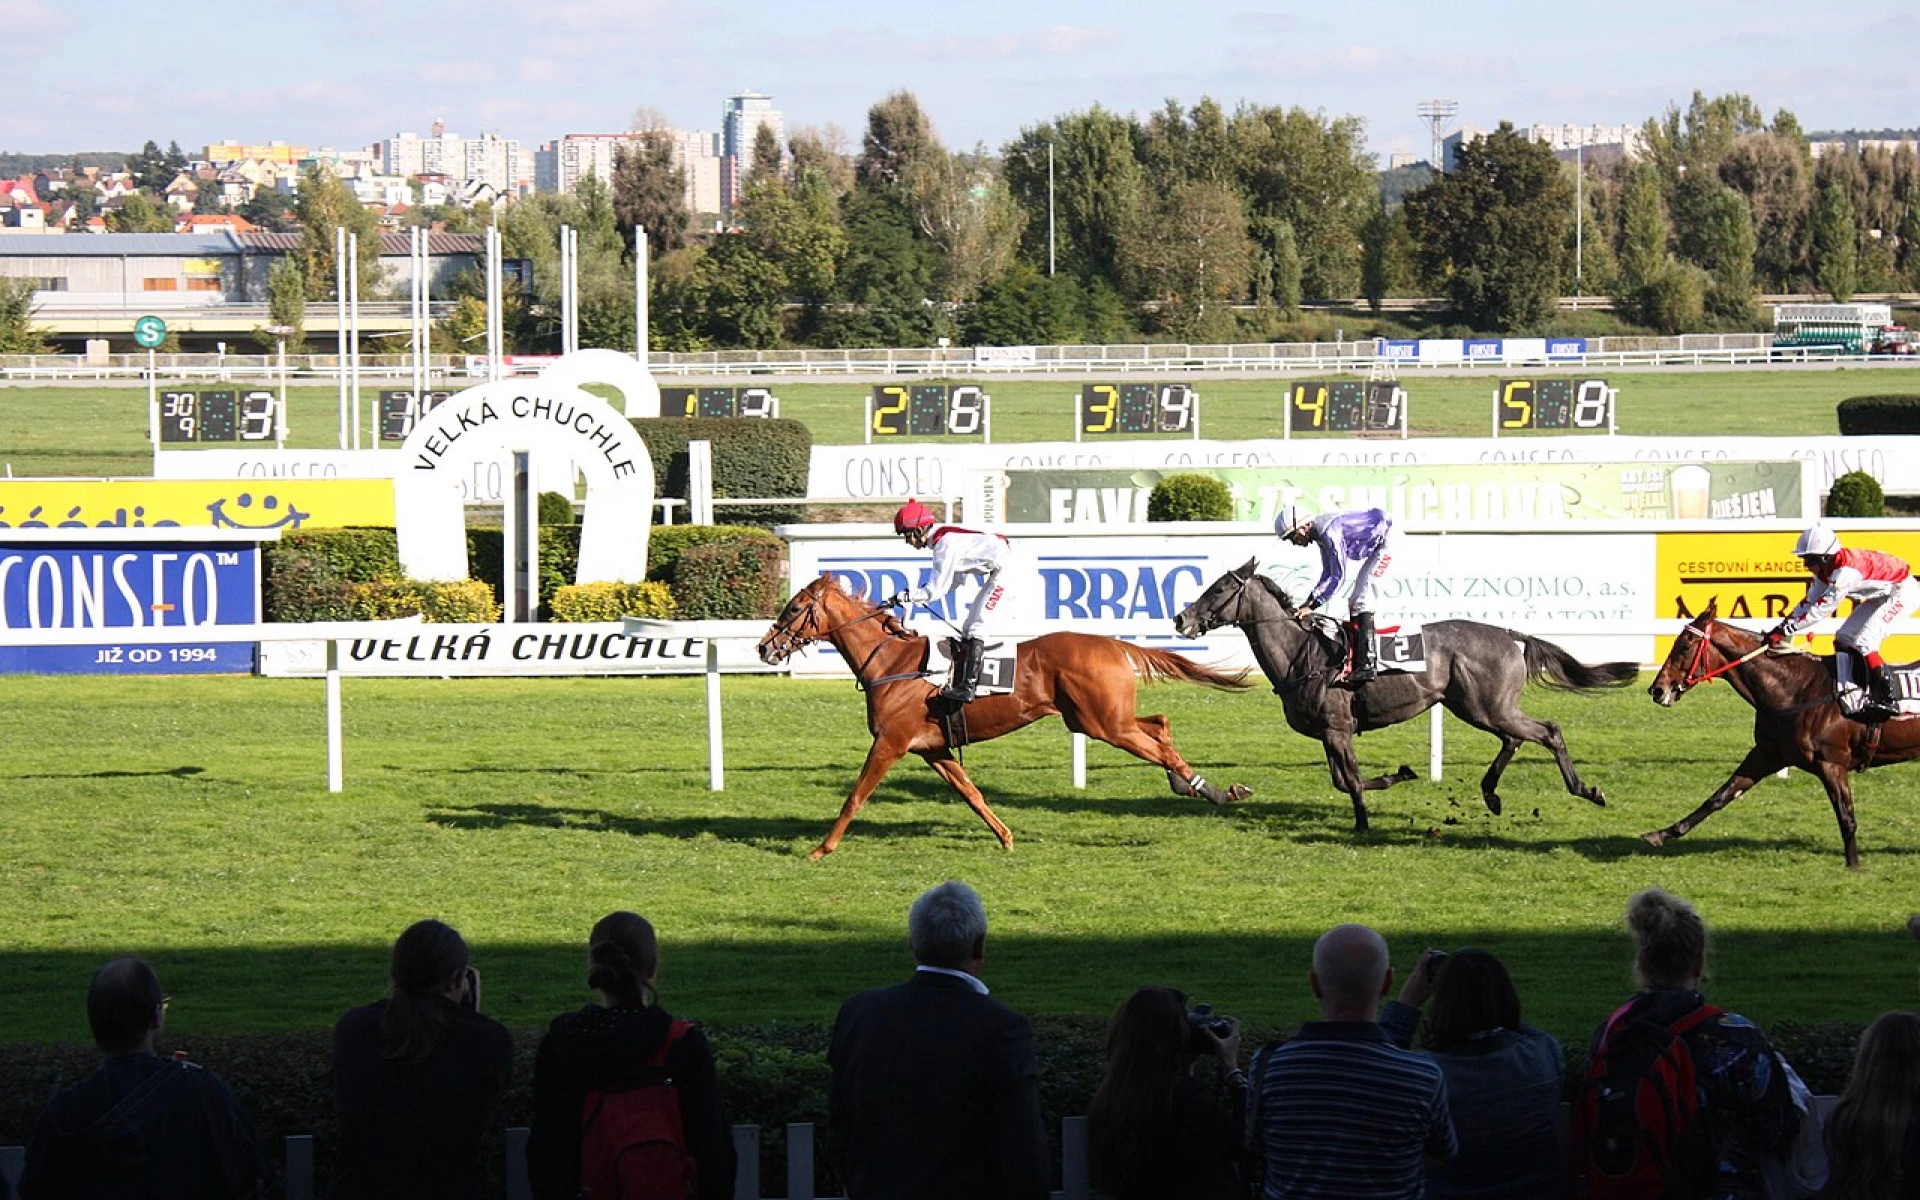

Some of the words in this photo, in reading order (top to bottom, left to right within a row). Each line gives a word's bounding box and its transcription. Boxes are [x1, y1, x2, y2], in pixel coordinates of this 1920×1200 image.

[143, 322, 158, 342] S
[164, 393, 194, 416] 30
[873, 388, 906, 433] 2
[1086, 386, 1117, 431] 3
[1295, 387, 1327, 427] 4
[1503, 382, 1531, 427] 5
[1574, 380, 1609, 428] 8
[180, 417, 195, 438] 9
[414, 397, 499, 470] VELKÁ
[512, 396, 636, 480] CHUCHLE
[845, 457, 942, 497] CONSEQ
[1678, 560, 1749, 573] CESTOVNÍ
[1463, 576, 1591, 603] ZNOJMO,
[1600, 581, 1636, 596] a.s.
[96, 646, 123, 663] JIŽ
[129, 648, 162, 662] OD
[169, 648, 216, 662] 1994
[349, 629, 491, 661] VELKÁ
[512, 633, 703, 660] CHUCHLE
[1395, 636, 1410, 661] 2
